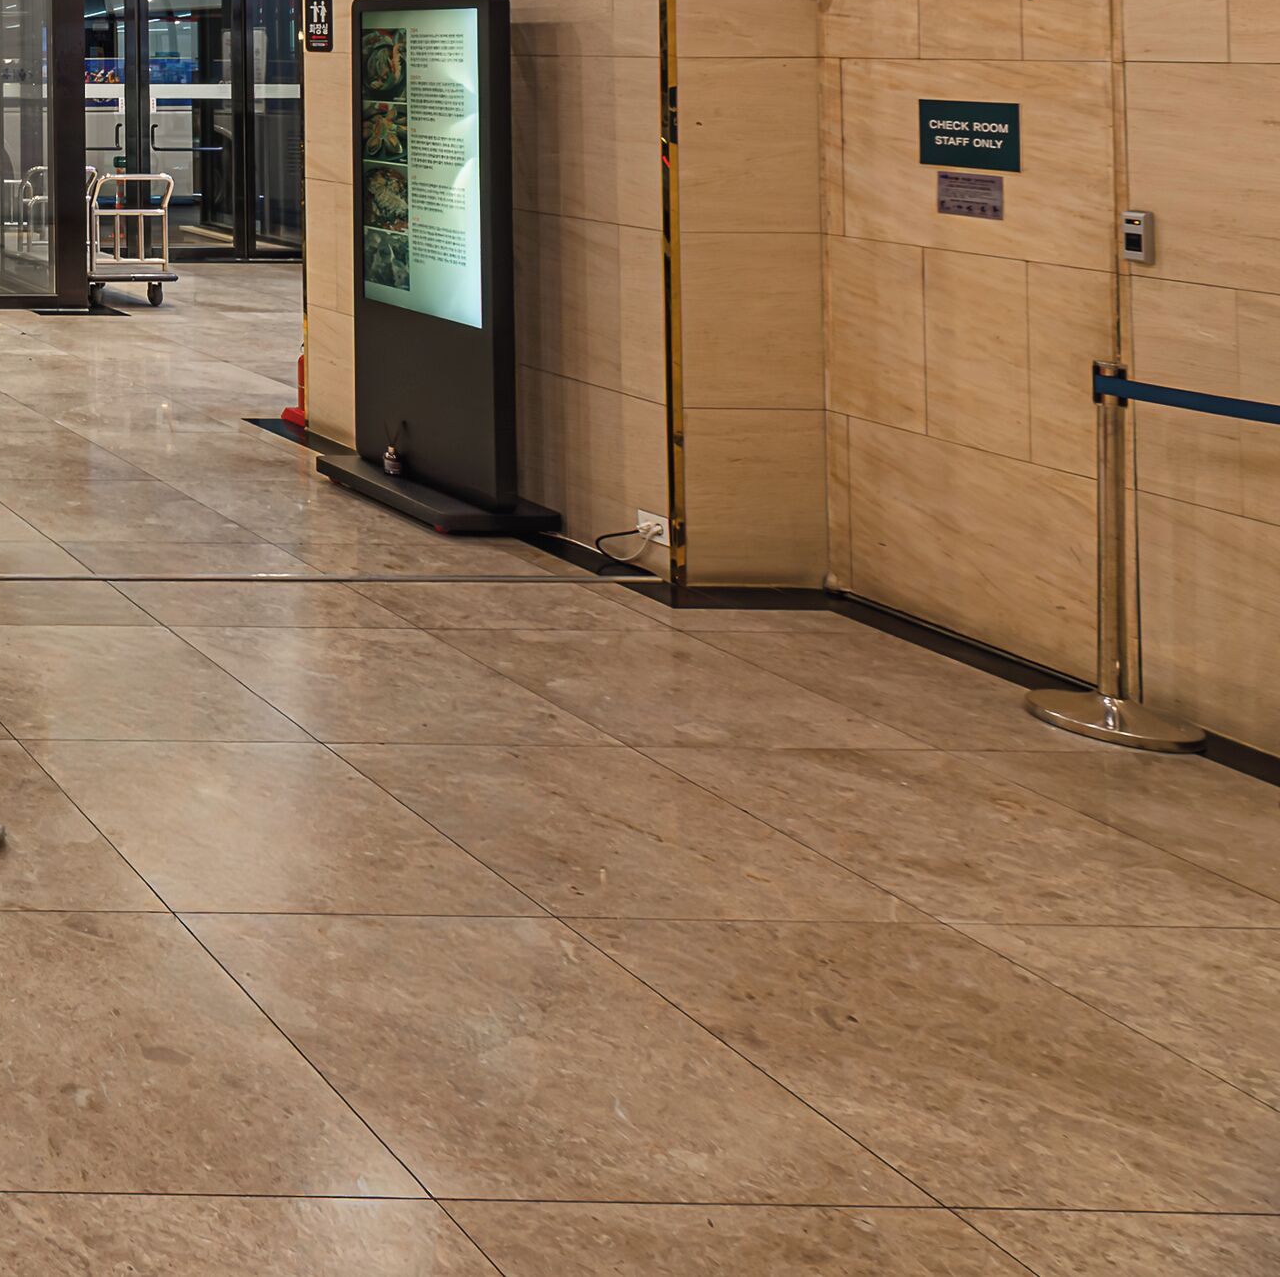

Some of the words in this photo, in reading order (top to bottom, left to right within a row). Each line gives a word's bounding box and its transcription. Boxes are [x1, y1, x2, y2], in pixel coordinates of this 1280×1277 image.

[309, 23, 329, 35] 화장실
[929, 120, 969, 131] CHECK
[973, 122, 1009, 133] ROOM
[935, 136, 970, 146] STAFF
[973, 138, 1003, 149] ONLY
